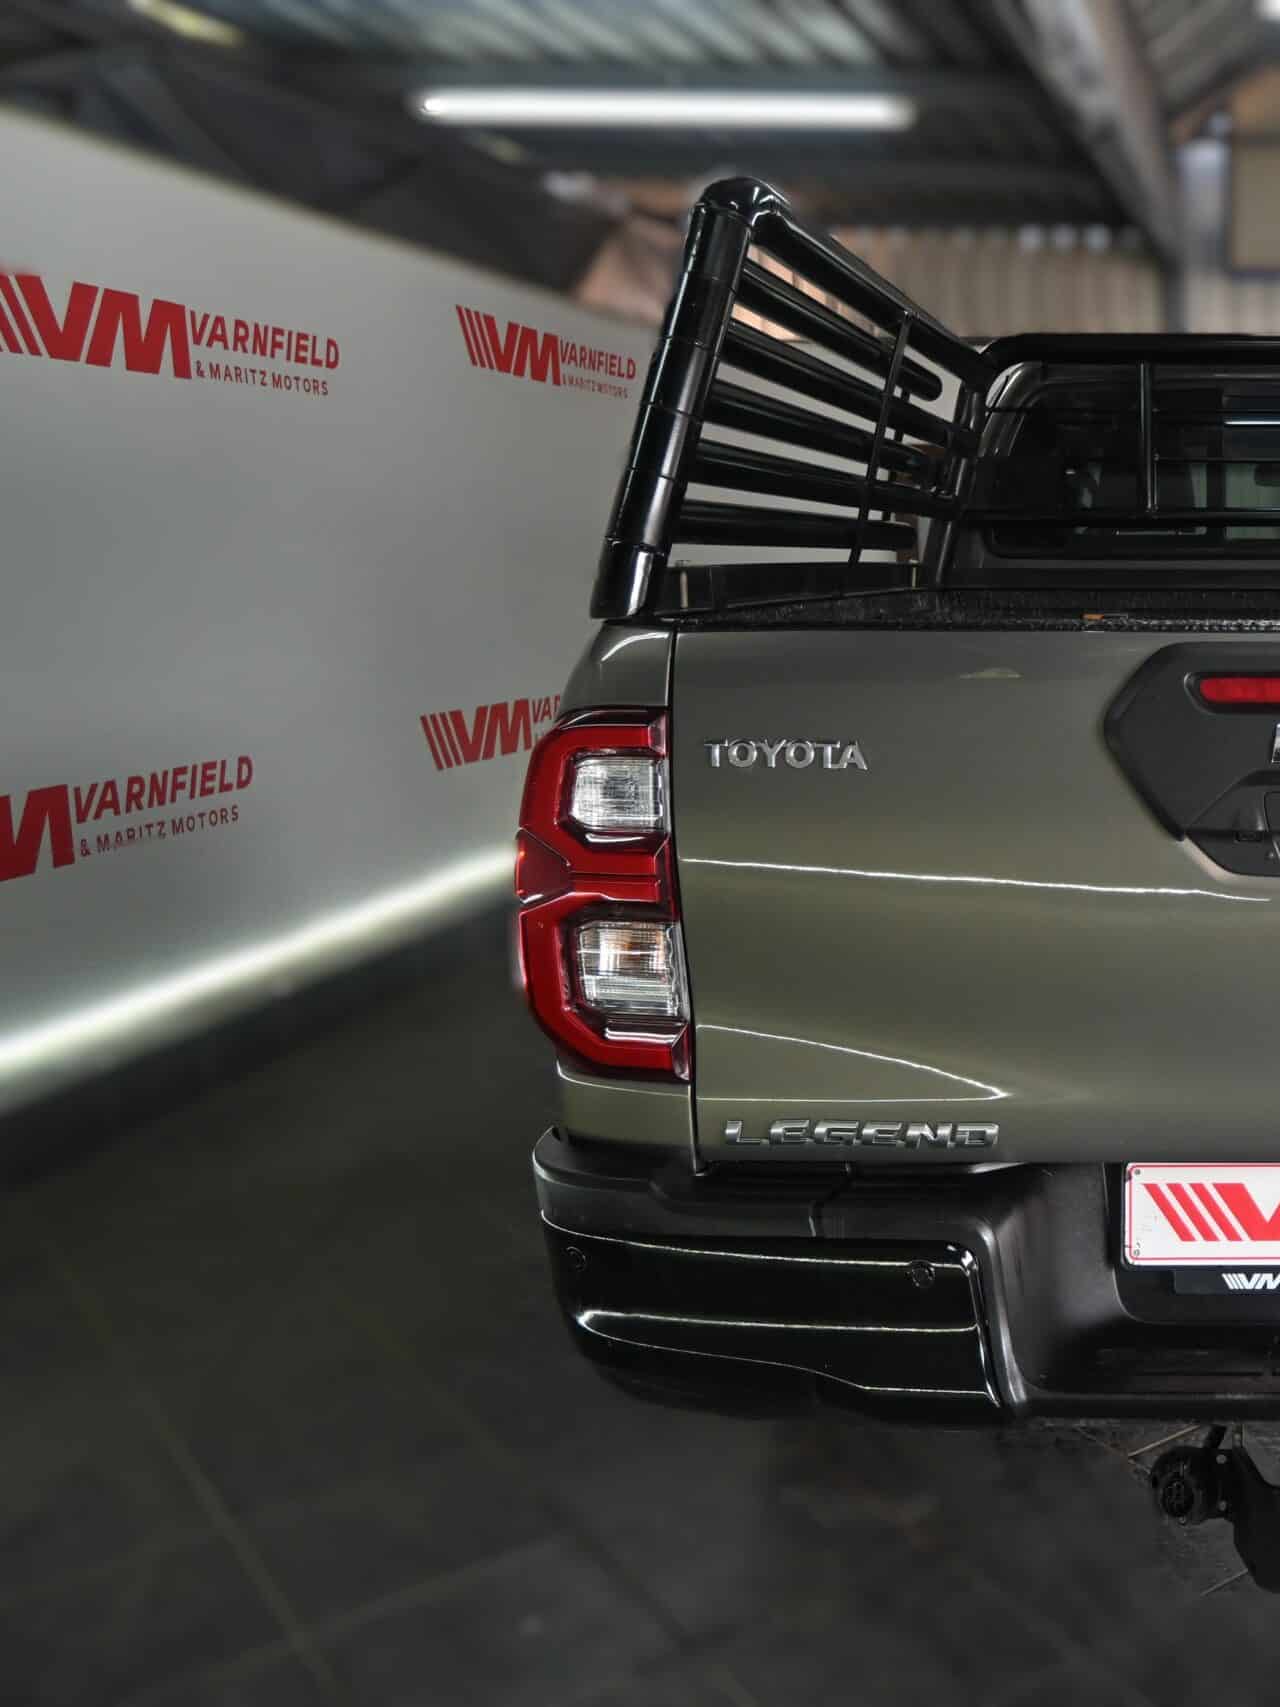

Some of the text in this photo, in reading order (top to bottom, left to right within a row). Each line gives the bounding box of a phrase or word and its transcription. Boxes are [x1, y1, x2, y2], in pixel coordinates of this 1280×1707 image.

[20, 274, 193, 380] VM
[189, 309, 340, 370] VARNFIELD
[482, 312, 561, 387] VM
[195, 360, 329, 396] & MARITZ MOTORS
[559, 338, 637, 380] VARNFIELD
[448, 697, 533, 764] VM
[703, 739, 868, 770] TOYOTA
[73, 755, 254, 825] VARNFIELD
[80, 804, 240, 857] & MARITZ MOTORS
[724, 1119, 1000, 1148] LEGEND
